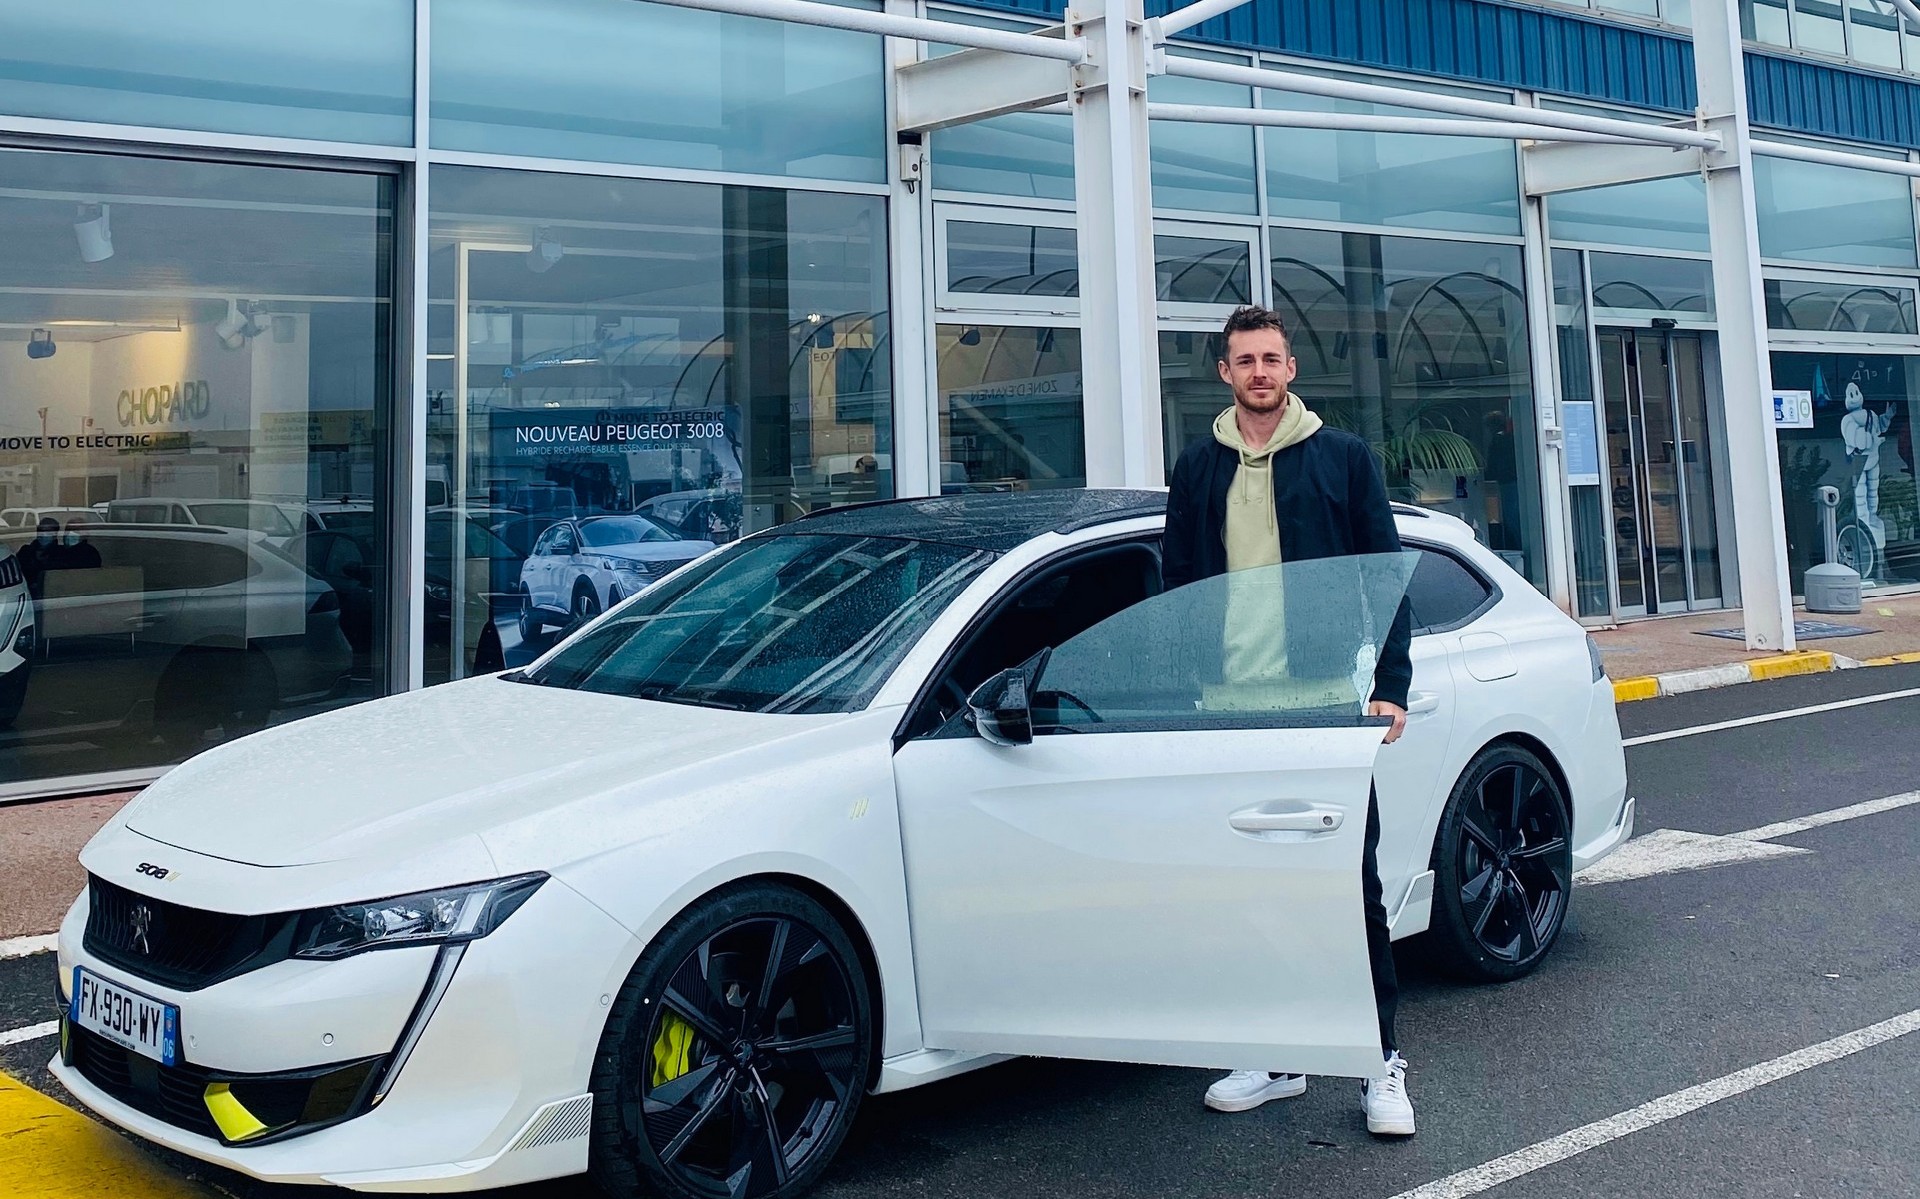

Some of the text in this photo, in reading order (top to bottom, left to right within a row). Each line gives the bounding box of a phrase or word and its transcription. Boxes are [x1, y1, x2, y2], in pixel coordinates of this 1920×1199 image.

[117, 380, 210, 428] CHOPARD
[614, 411, 725, 424] MOVE TO ELECTRIC
[516, 422, 725, 443] NOUVEAU PEUGEOT 3008
[47, 436, 70, 449] TO
[76, 434, 150, 448] ELECTRIC
[516, 446, 552, 456] HYBRIDE
[619, 443, 651, 453] ESSENCE
[135, 862, 169, 879] 508
[162, 1037, 175, 1059] 06
